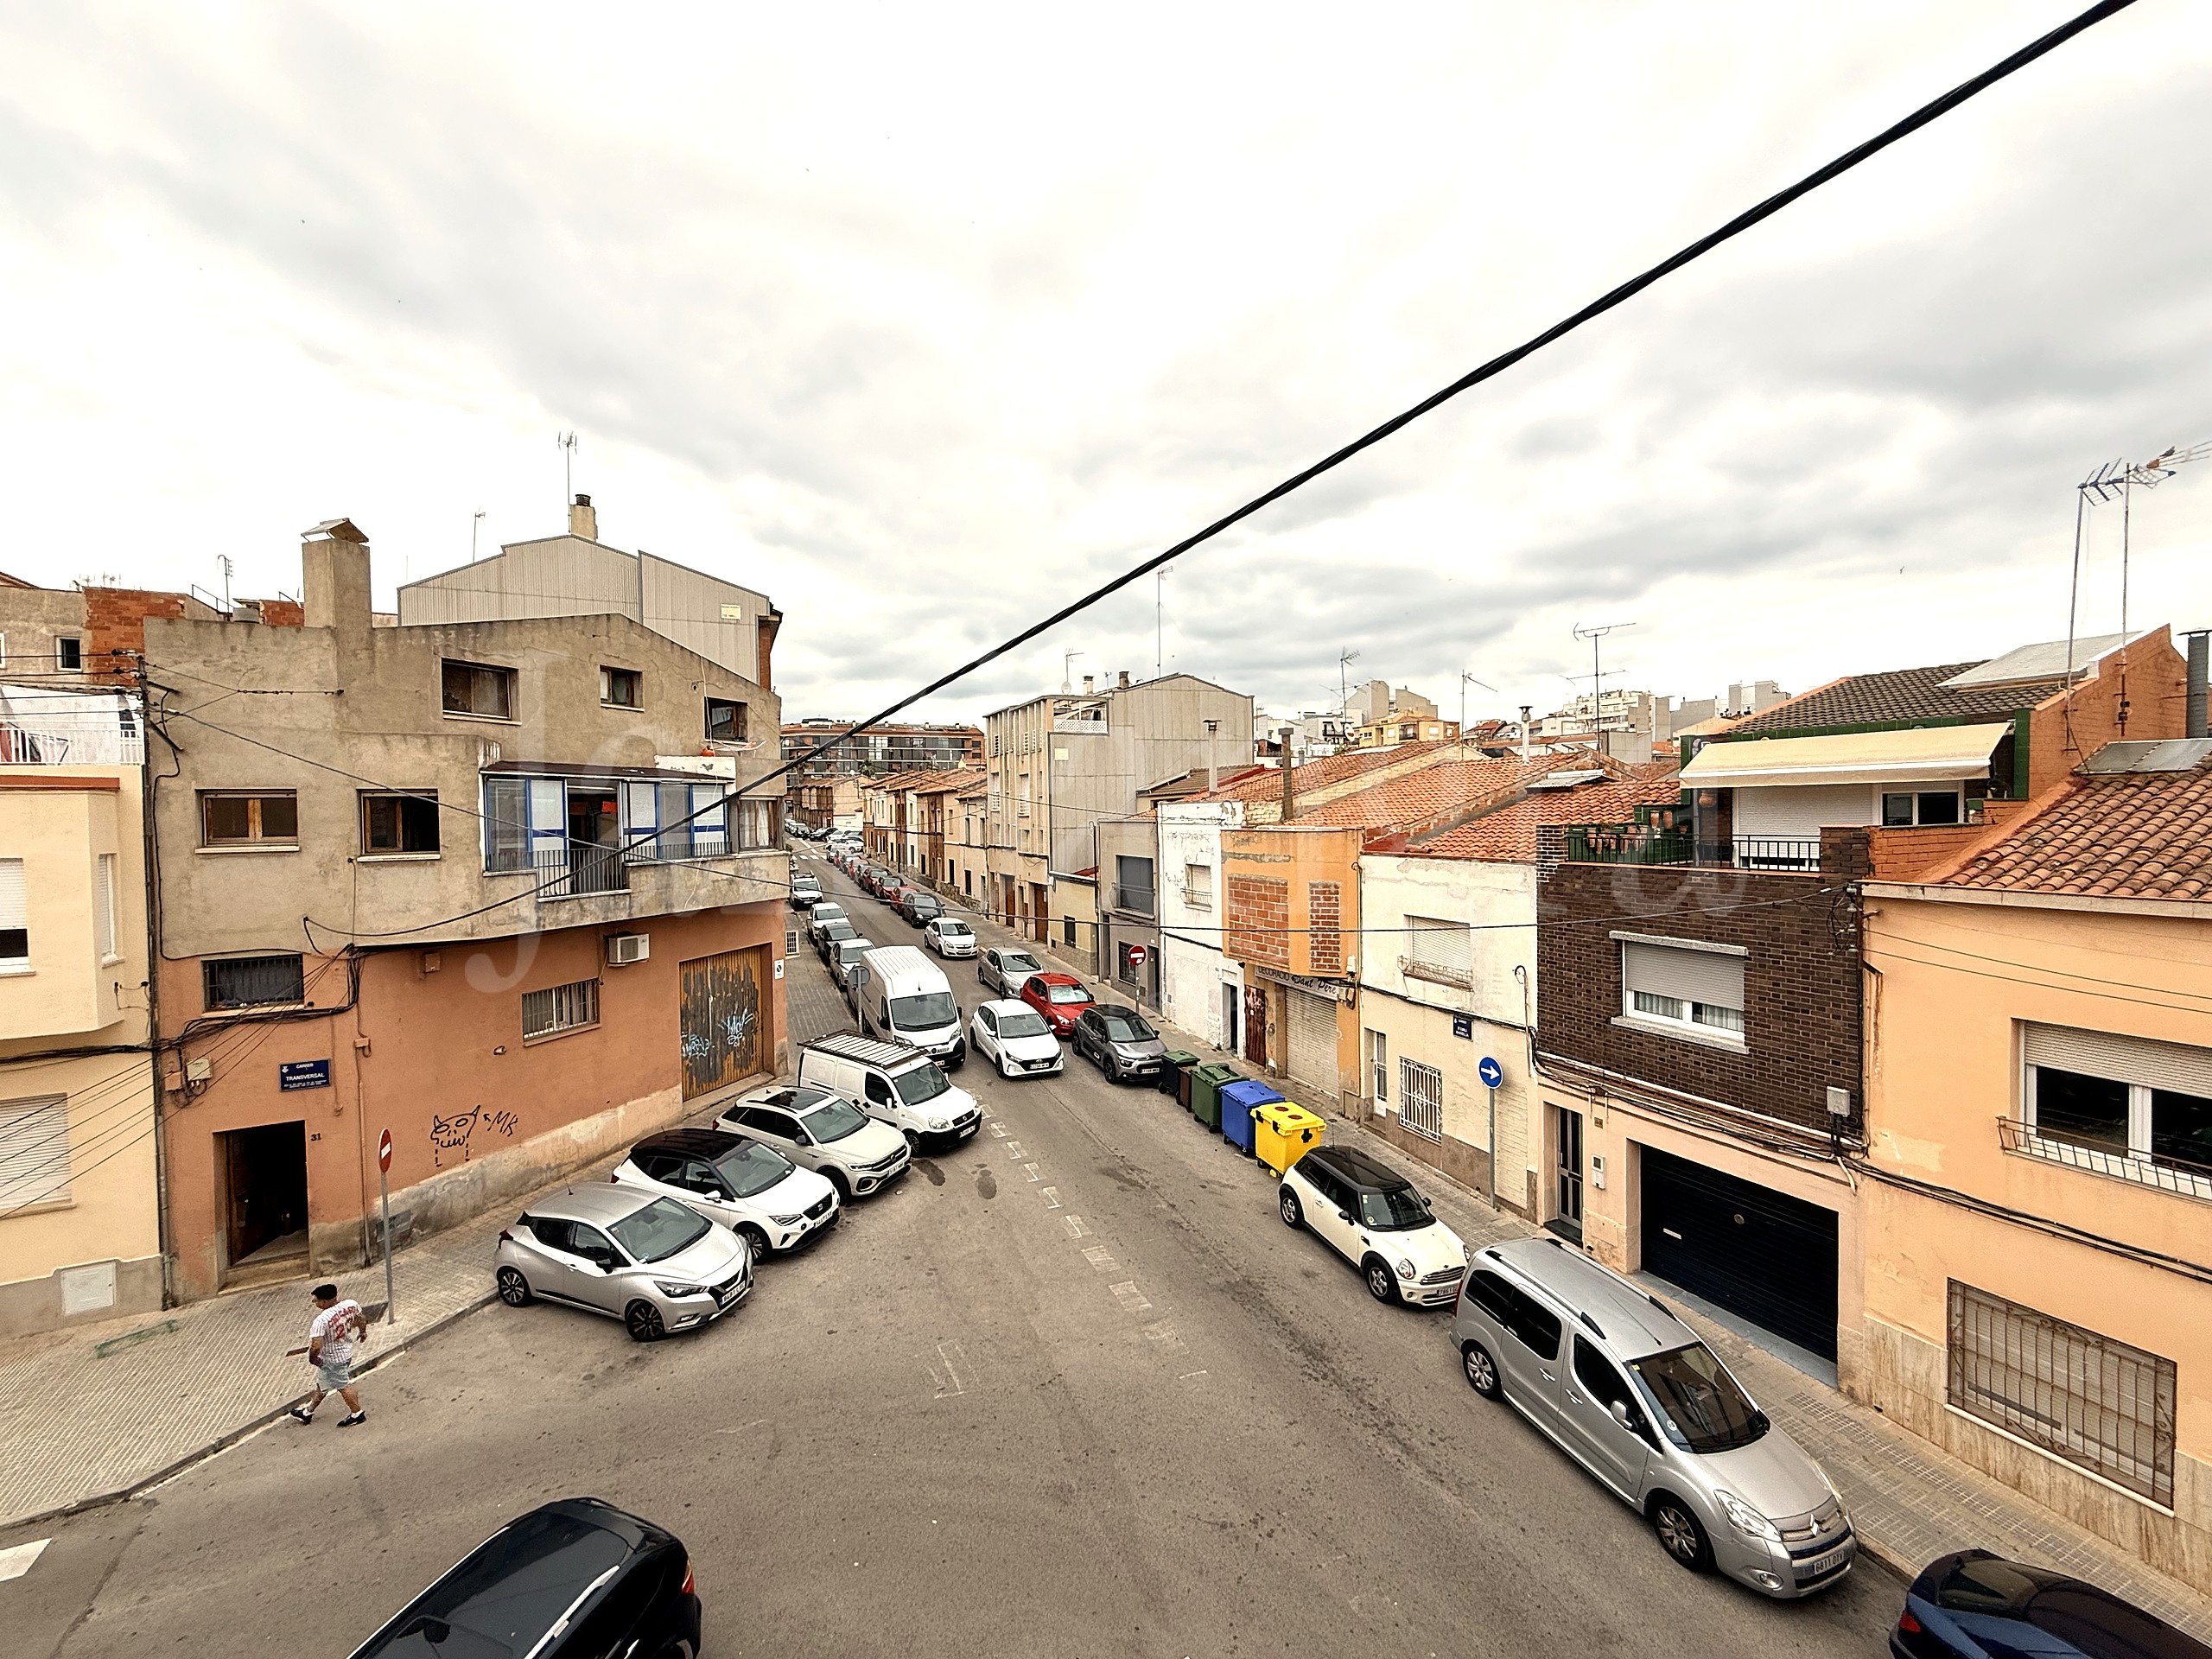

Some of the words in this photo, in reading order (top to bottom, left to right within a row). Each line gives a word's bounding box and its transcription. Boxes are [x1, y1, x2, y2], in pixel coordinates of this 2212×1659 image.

[1291, 974, 1313, 988] Sant
[1317, 979, 1337, 995] Pere
[285, 1072, 325, 1082] TRANSVERSAL
[310, 1132, 322, 1141] 31
